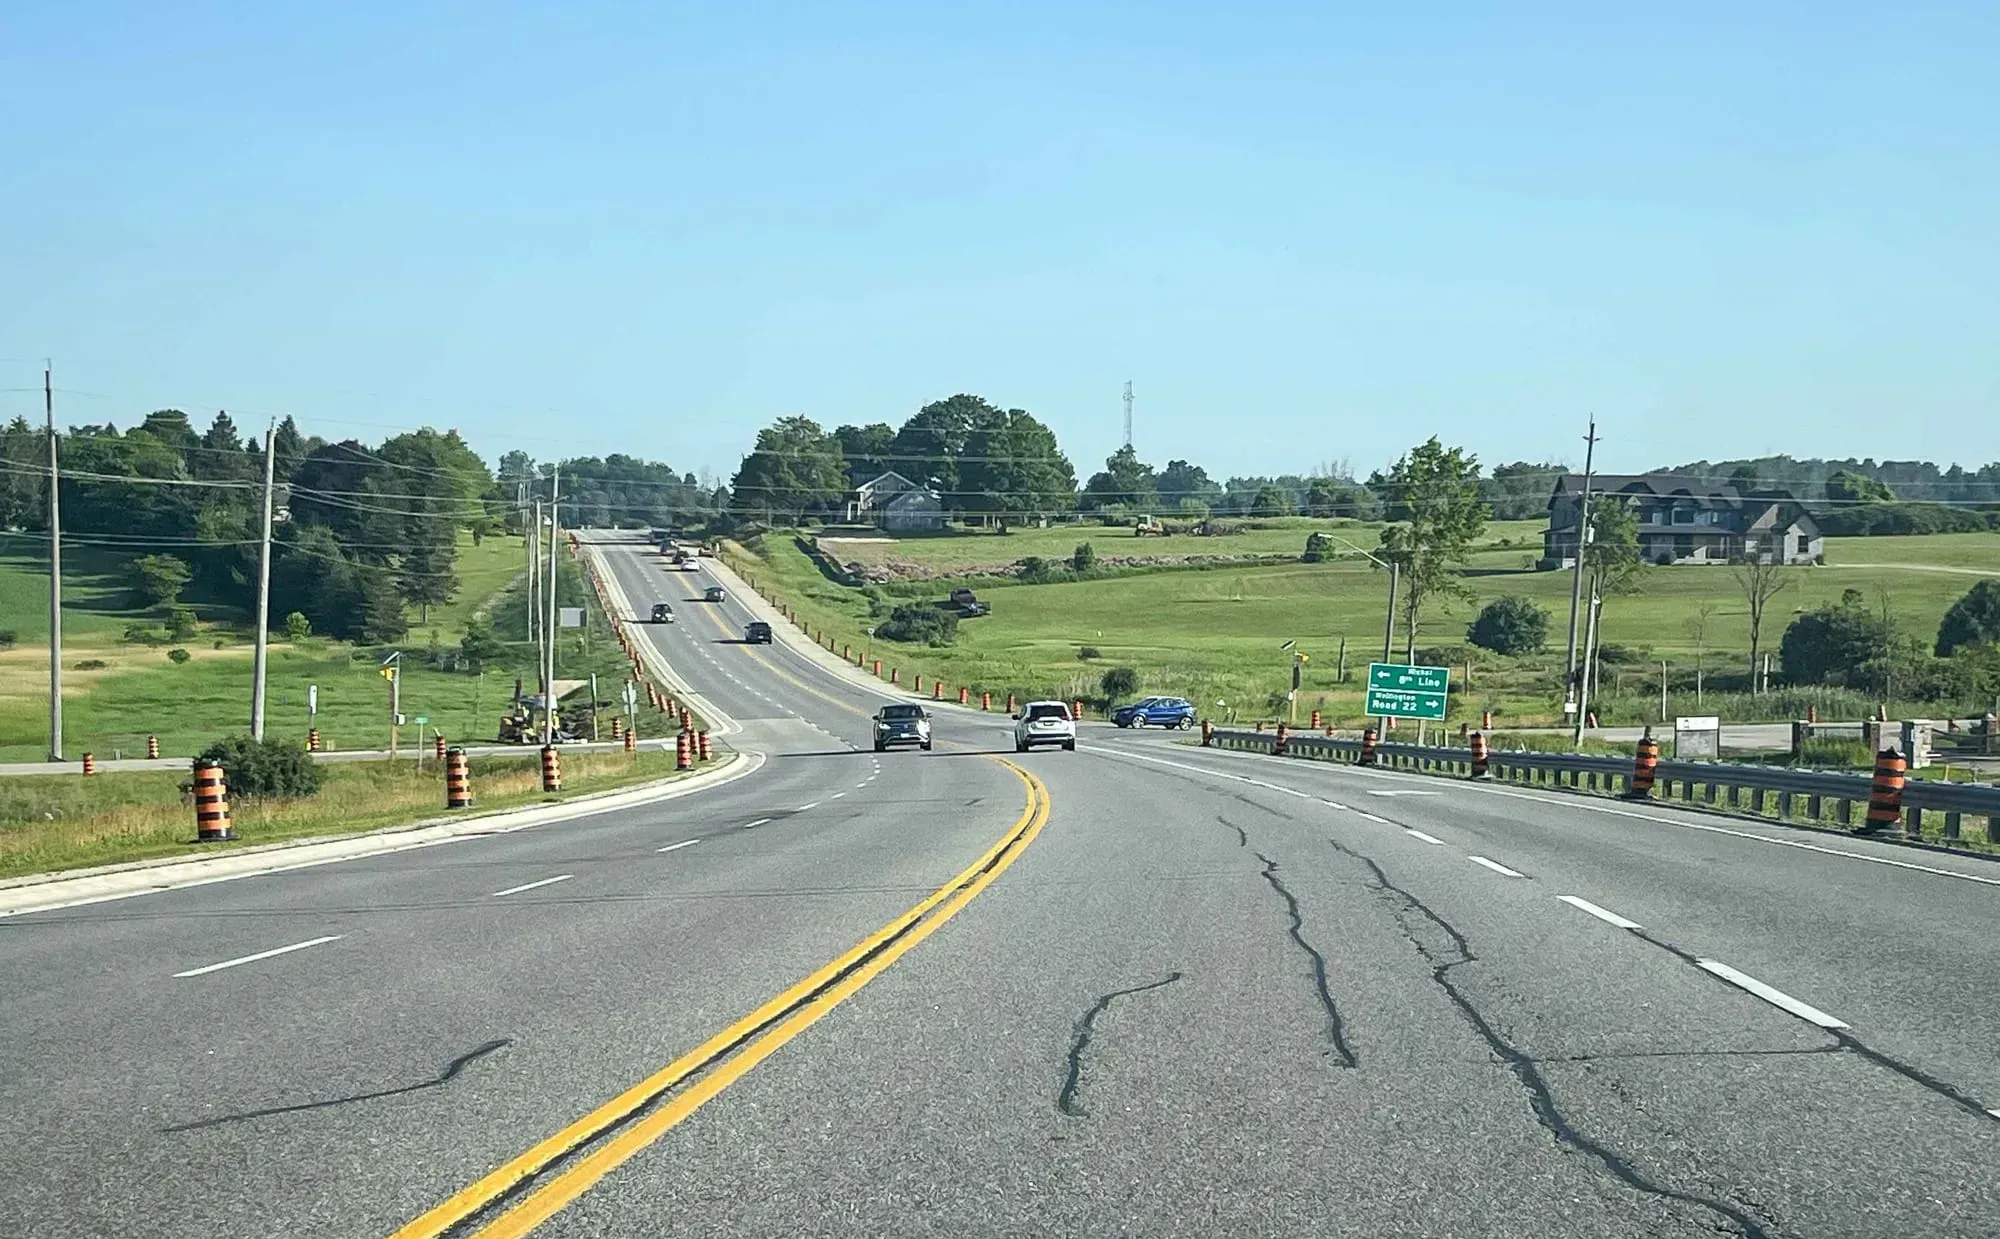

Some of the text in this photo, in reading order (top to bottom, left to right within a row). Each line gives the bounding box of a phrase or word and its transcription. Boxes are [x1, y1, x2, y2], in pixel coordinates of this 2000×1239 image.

[1418, 677, 1440, 687] Line
[1372, 699, 1417, 711] Road 22
